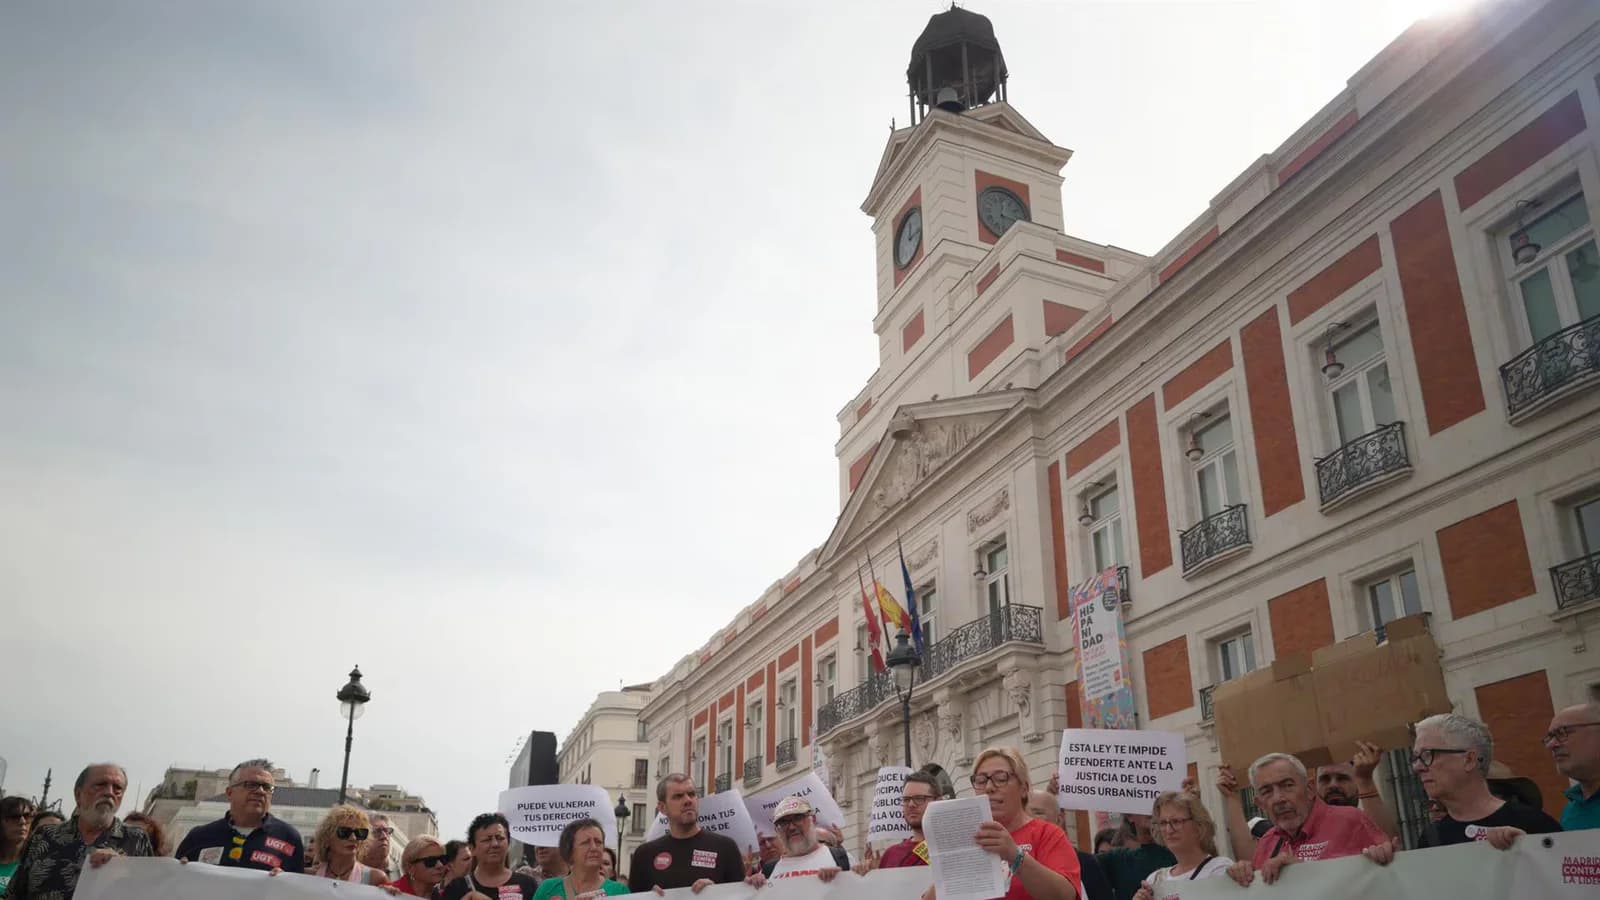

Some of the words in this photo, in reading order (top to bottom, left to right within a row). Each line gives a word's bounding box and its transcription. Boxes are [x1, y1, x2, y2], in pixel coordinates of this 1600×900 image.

[1079, 603, 1095, 618] HIS
[1080, 617, 1093, 628] PA
[1081, 628, 1091, 638] NI
[1082, 634, 1103, 650] DAD
[1069, 743, 1091, 753] ESTA
[1093, 744, 1112, 753] LEY
[1114, 745, 1126, 754] TE
[1128, 746, 1167, 756] IMPIDE
[1064, 757, 1125, 769] DEFENDERTE
[1127, 760, 1157, 770] ANTE
[1158, 762, 1174, 771] LA
[1075, 772, 1119, 782] JUSTICIA
[1120, 774, 1135, 783] DE
[1136, 775, 1157, 784] LOS
[1060, 785, 1096, 795] ABUSOS
[1098, 787, 1160, 799] URBANÍSTIC
[517, 802, 547, 811] PUEDE
[548, 800, 596, 809] VULNERAR
[524, 813, 542, 822] TUS
[542, 811, 590, 821] DERECHOS
[659, 817, 669, 825] NO
[718, 808, 736, 819] TUS
[877, 811, 887, 820] LA
[718, 822, 730, 831] DE
[1563, 876, 1576, 884] LA
[1578, 876, 1600, 885] LIDE
